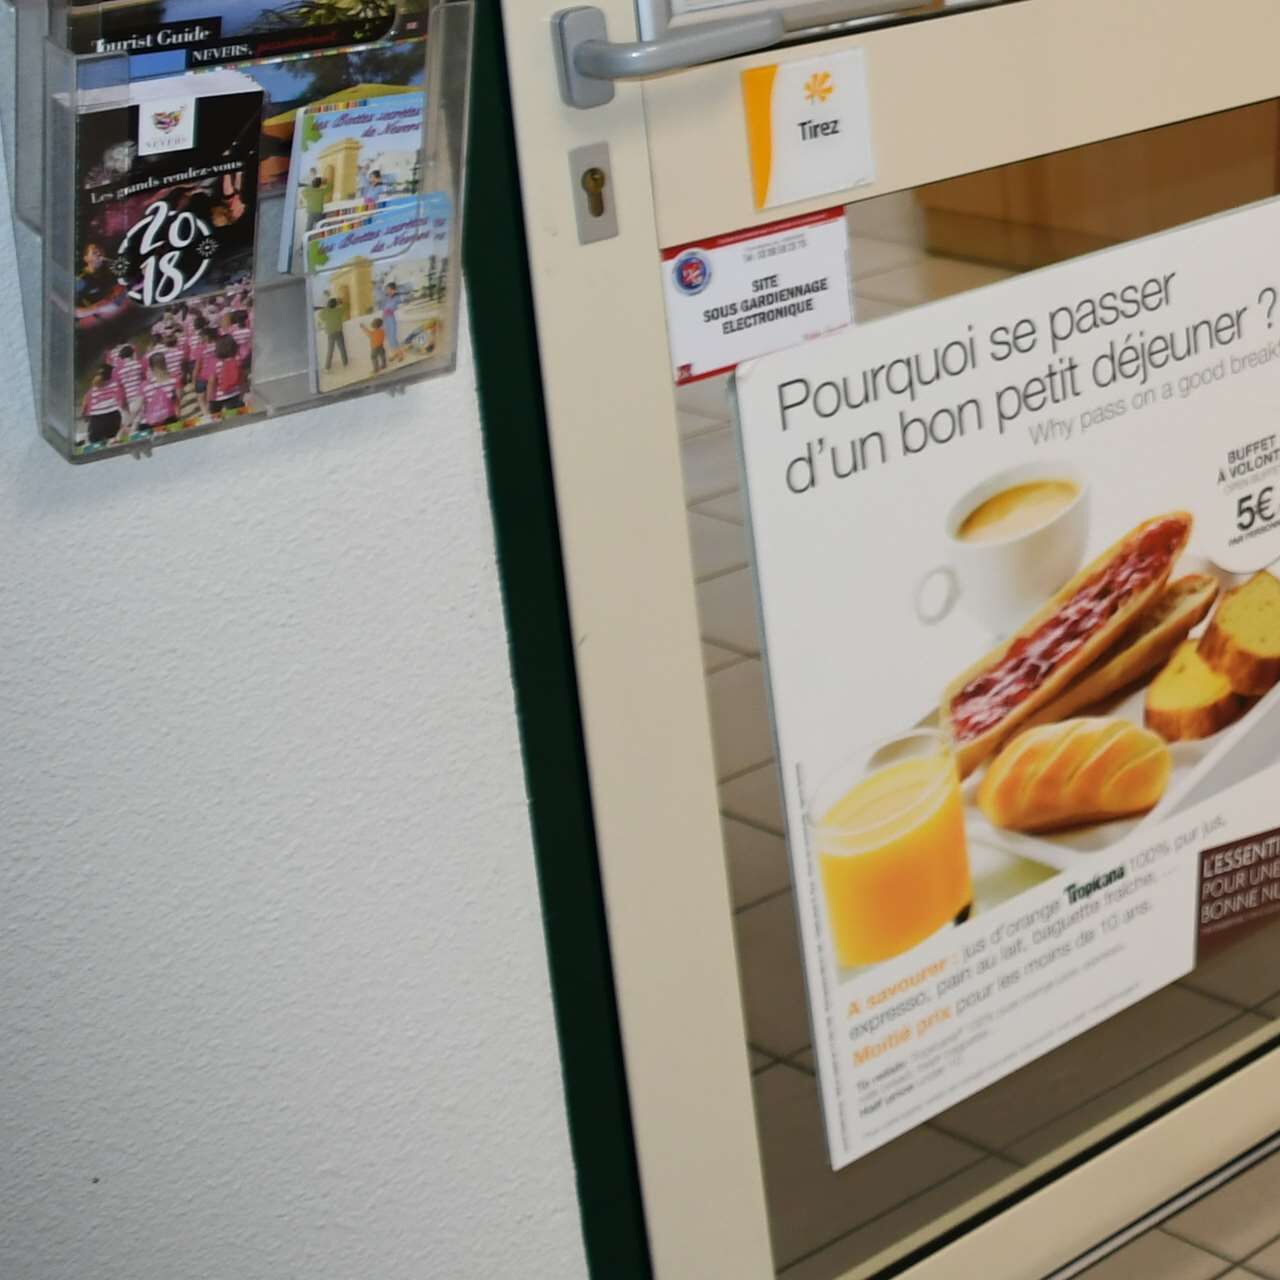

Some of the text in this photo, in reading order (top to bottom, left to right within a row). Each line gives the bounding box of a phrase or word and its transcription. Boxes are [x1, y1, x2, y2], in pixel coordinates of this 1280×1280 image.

[91, 25, 211, 53] Tourist Guide
[797, 117, 841, 142] Tirez
[91, 160, 243, 205] Les grands rendez-vous
[702, 277, 829, 323] SOUS GARDIENNAGE
[752, 273, 779, 293] SITE
[722, 298, 815, 335] ELECTRONIQUE
[777, 268, 1178, 432] Pourquoi se passer
[900, 396, 984, 457] bon
[995, 350, 1083, 435] petit
[1091, 305, 1248, 388] déjeuner
[1028, 415, 1076, 449] Why
[1079, 394, 1129, 431] pass
[1131, 387, 1160, 411] on
[1161, 382, 1175, 401] a
[1178, 361, 1227, 401] good
[1227, 433, 1277, 464] BUFFET
[1236, 486, 1276, 531] 5€
[1201, 888, 1258, 924] BONNE
[1202, 871, 1245, 900] POUR
[961, 936, 987, 961] jus
[1063, 863, 1126, 905] Tropicana
[955, 983, 996, 1018] pour
[998, 968, 1021, 991] les
[1022, 943, 1073, 980] moins
[1074, 929, 1096, 951] de
[975, 955, 999, 979] au
